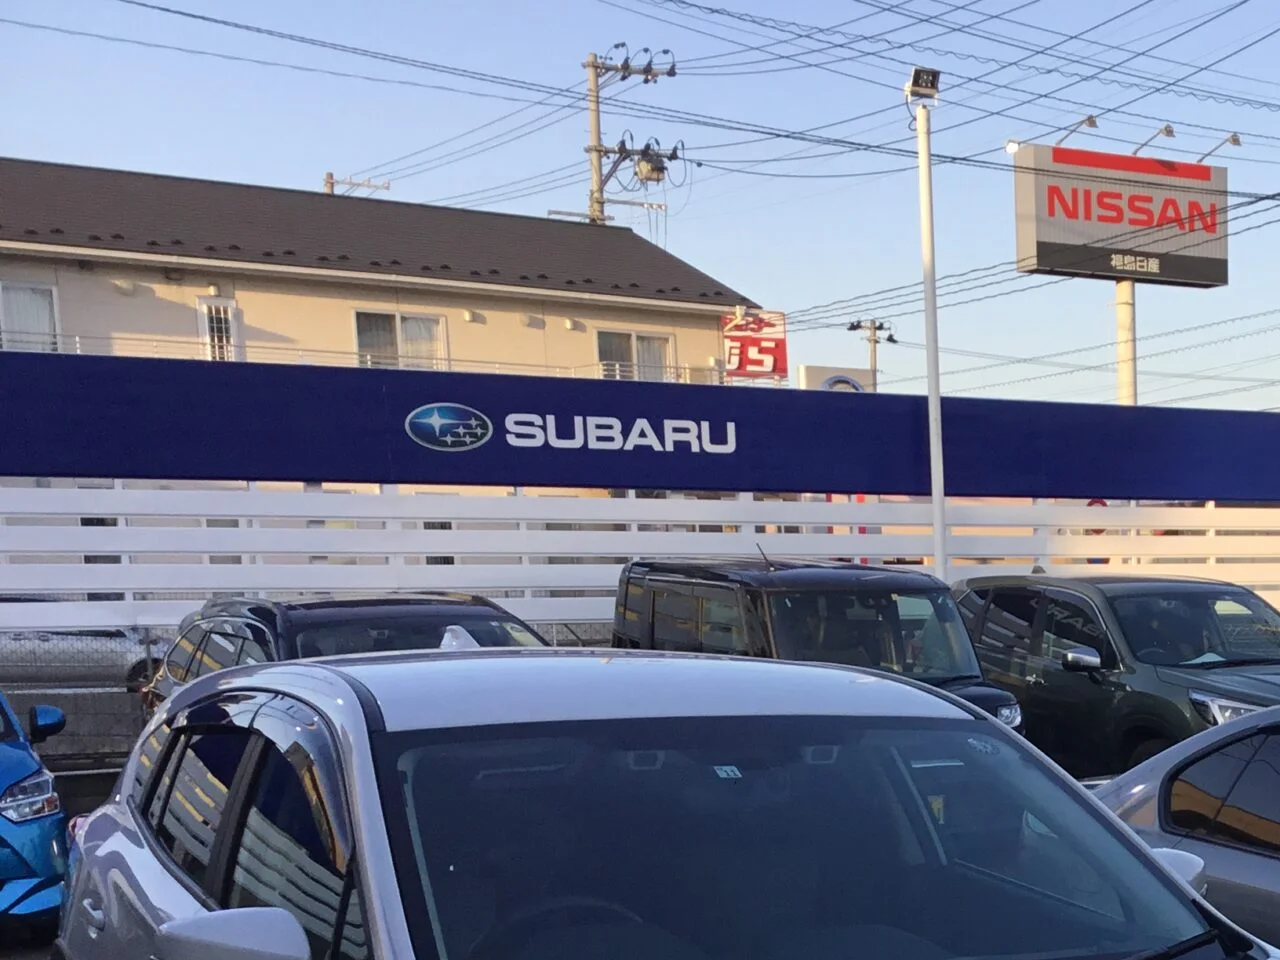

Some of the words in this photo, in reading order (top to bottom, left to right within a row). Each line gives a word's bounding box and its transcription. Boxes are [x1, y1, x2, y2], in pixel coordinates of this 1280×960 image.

[1047, 184, 1217, 234] NISSAN
[1110, 253, 1161, 273] 福島日産
[504, 412, 737, 454] SUBARU
